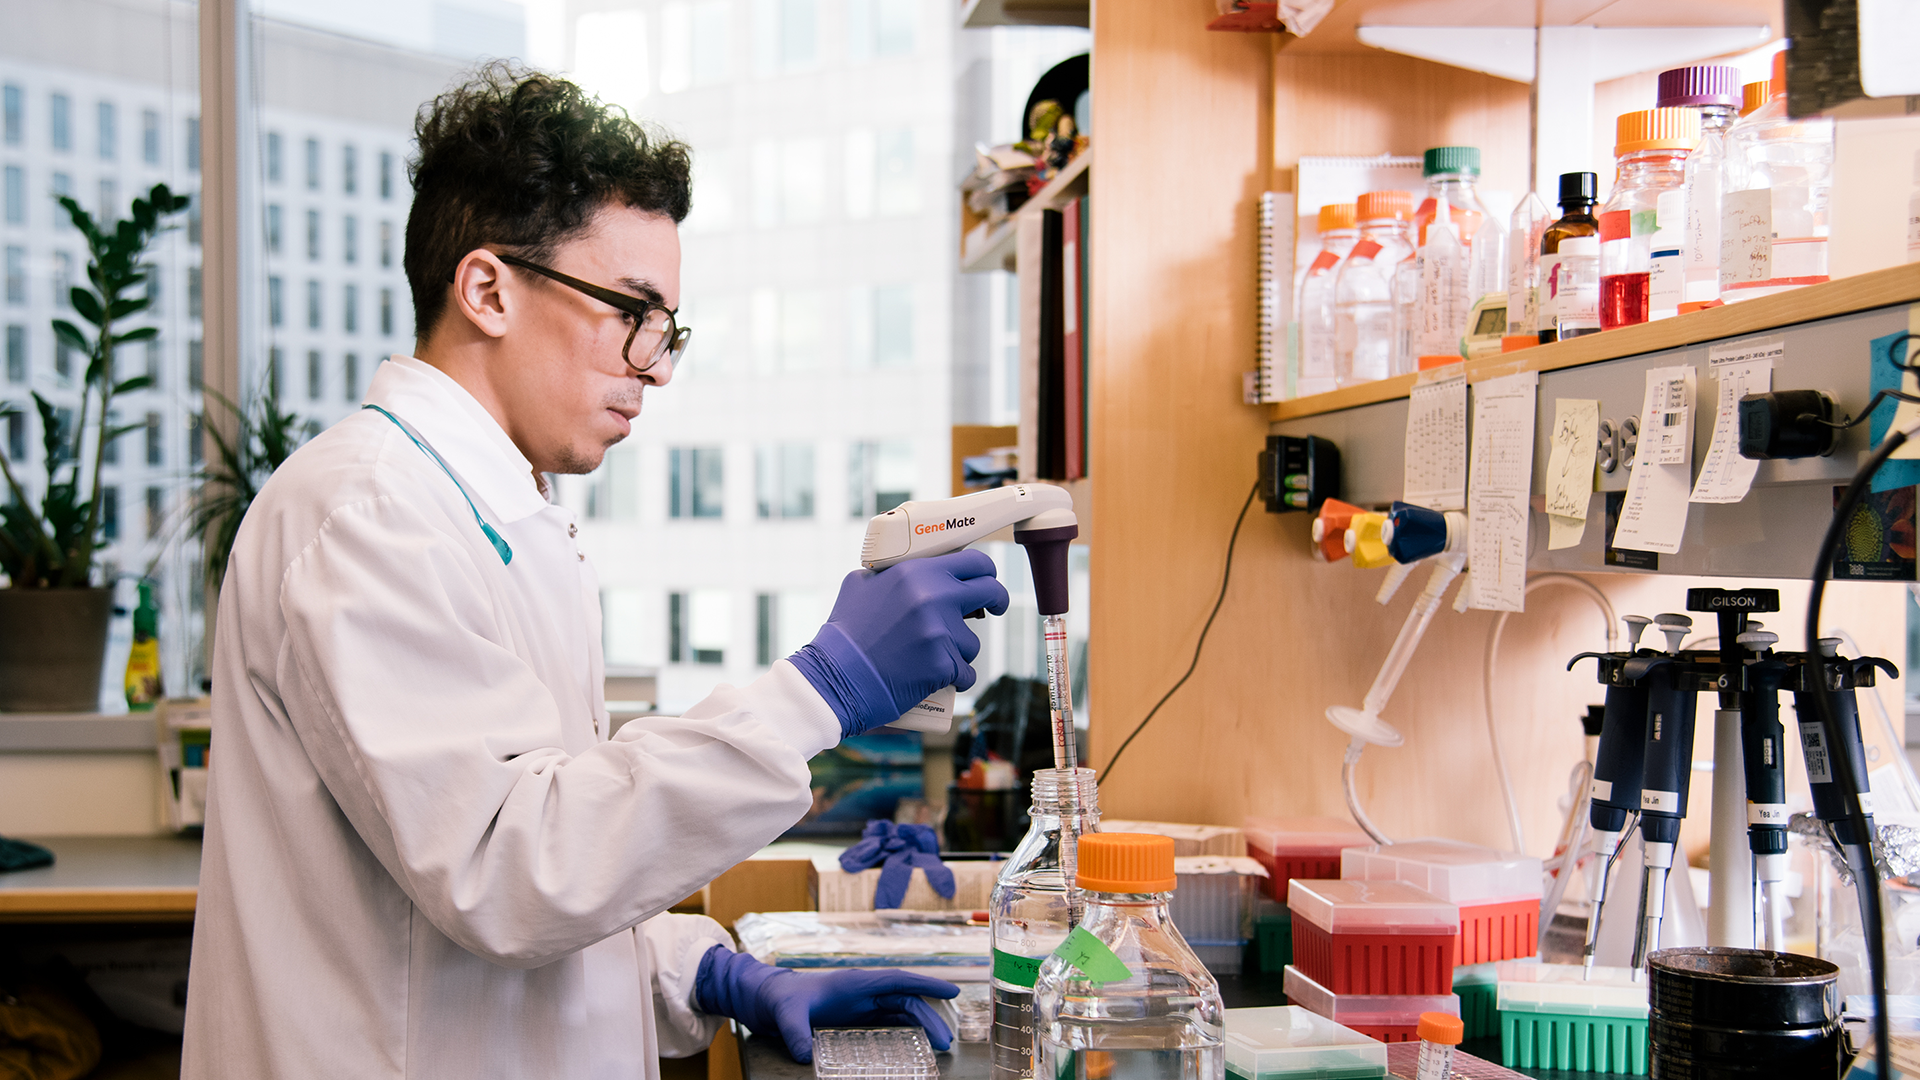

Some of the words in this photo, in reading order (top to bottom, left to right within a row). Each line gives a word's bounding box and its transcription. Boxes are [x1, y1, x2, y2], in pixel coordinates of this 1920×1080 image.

[1508, 263, 1519, 299] TAE
[915, 516, 976, 535] GeneMate
[1712, 596, 1756, 607] GILSON
[1612, 669, 1619, 682] 5
[1717, 674, 1728, 688] 6
[915, 703, 945, 713] ioExpress
[1057, 718, 1065, 748] costar
[1651, 796, 1660, 804] Jin
[1759, 810, 1770, 818] Yea
[1771, 810, 1780, 818] Jin
[1021, 939, 1037, 948] 800
[1026, 962, 1039, 974] PB
